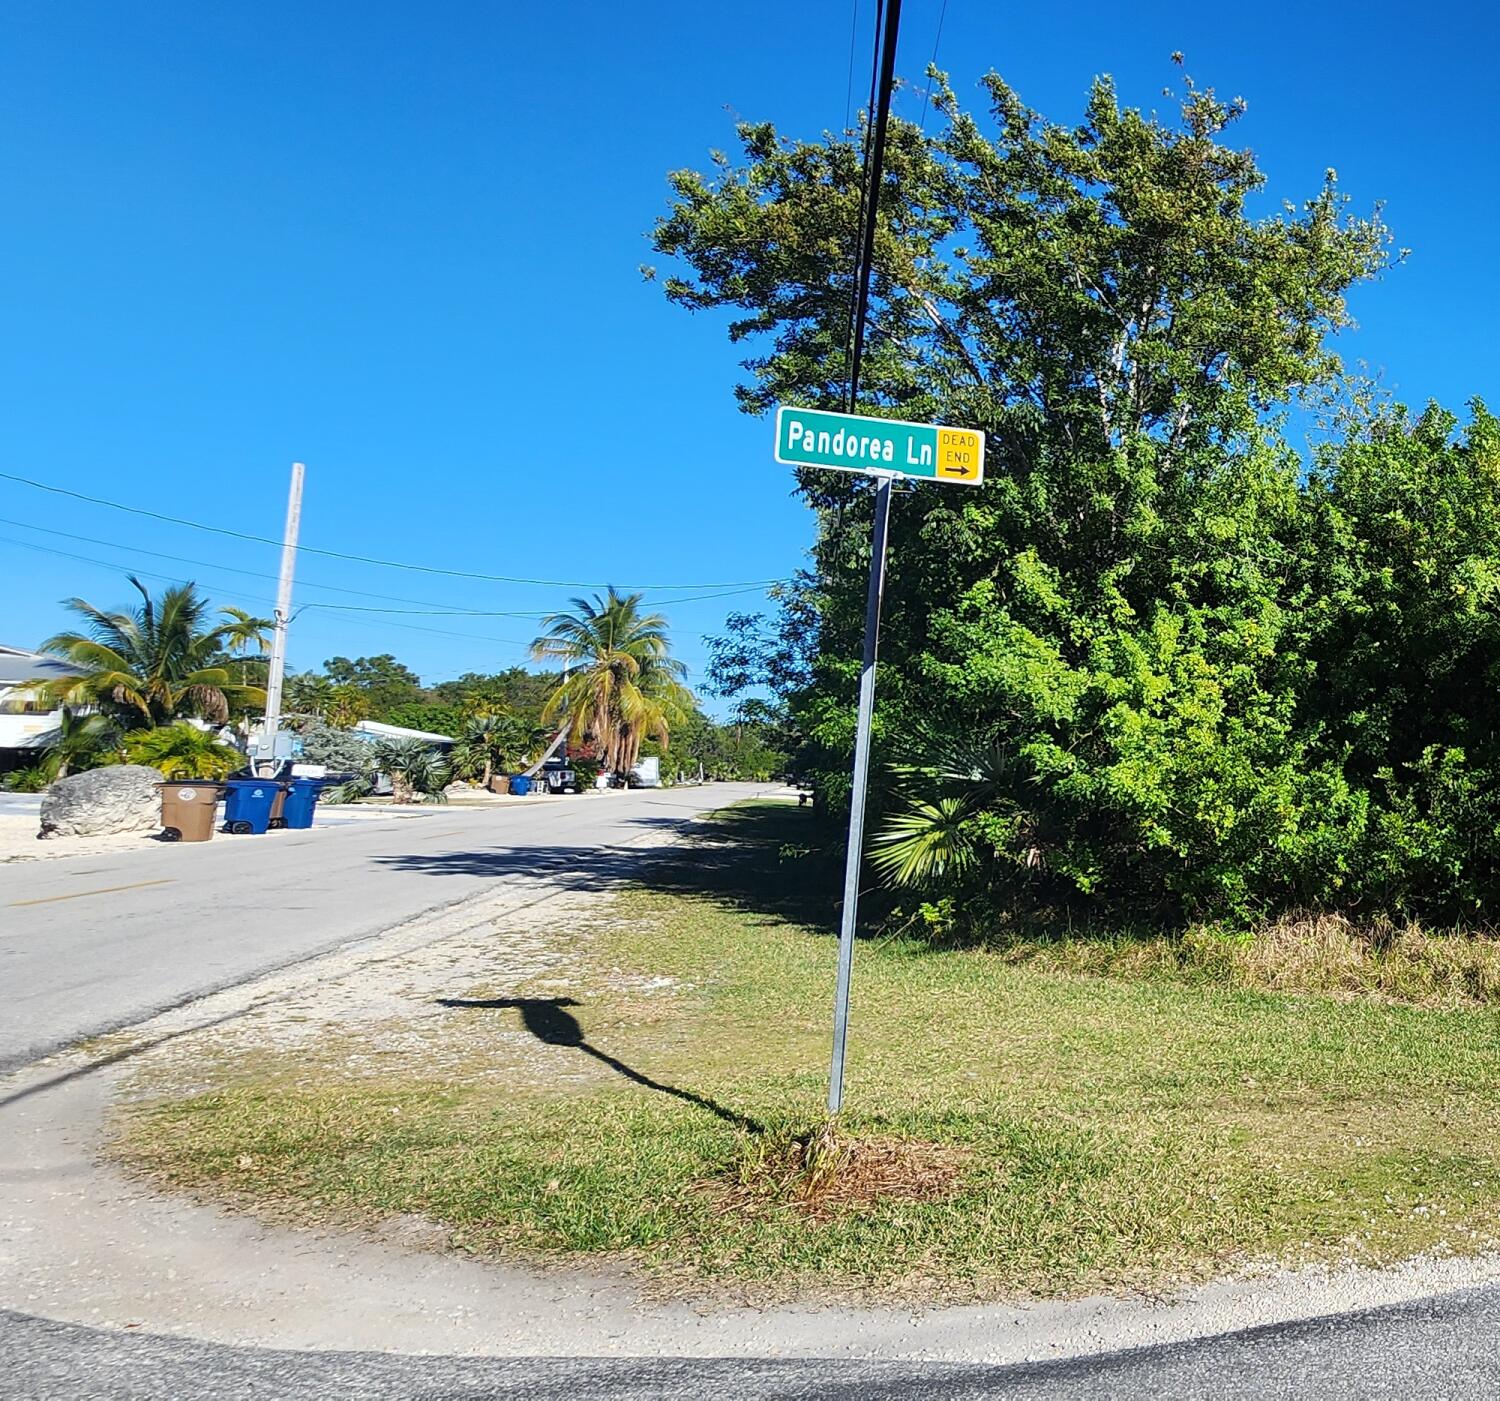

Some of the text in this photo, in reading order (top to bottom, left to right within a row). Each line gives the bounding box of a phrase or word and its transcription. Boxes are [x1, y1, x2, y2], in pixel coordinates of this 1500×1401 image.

[788, 421, 932, 466] Pandorea Ln
[943, 434, 975, 447] DEAD
[946, 451, 970, 463] END
